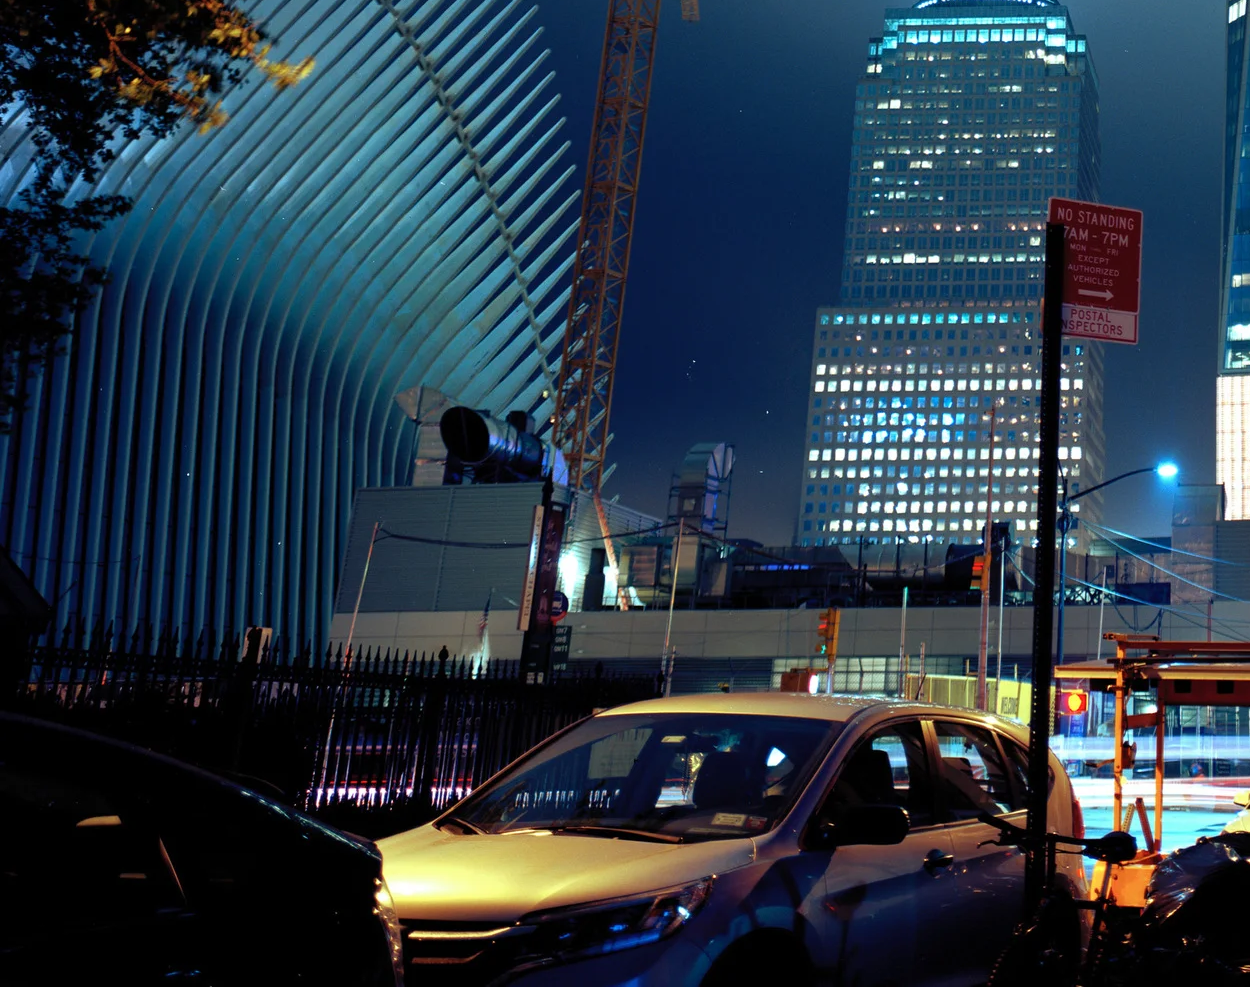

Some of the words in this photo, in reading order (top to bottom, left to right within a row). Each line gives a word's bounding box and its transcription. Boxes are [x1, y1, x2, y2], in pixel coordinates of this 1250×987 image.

[1057, 207, 1073, 222] NO
[1078, 211, 1135, 231] STANDING
[1064, 226, 1088, 242] 7AM
[1102, 231, 1129, 248] 7PM
[1070, 243, 1087, 252] MON
[1107, 248, 1119, 256] FRI
[1078, 254, 1110, 266] EXCEPT
[1067, 263, 1120, 277] AUTHORIZED
[1073, 274, 1114, 287] VEHICLES
[1070, 308, 1112, 324] POSTAL
[1062, 319, 1123, 336] NSPECTORS
